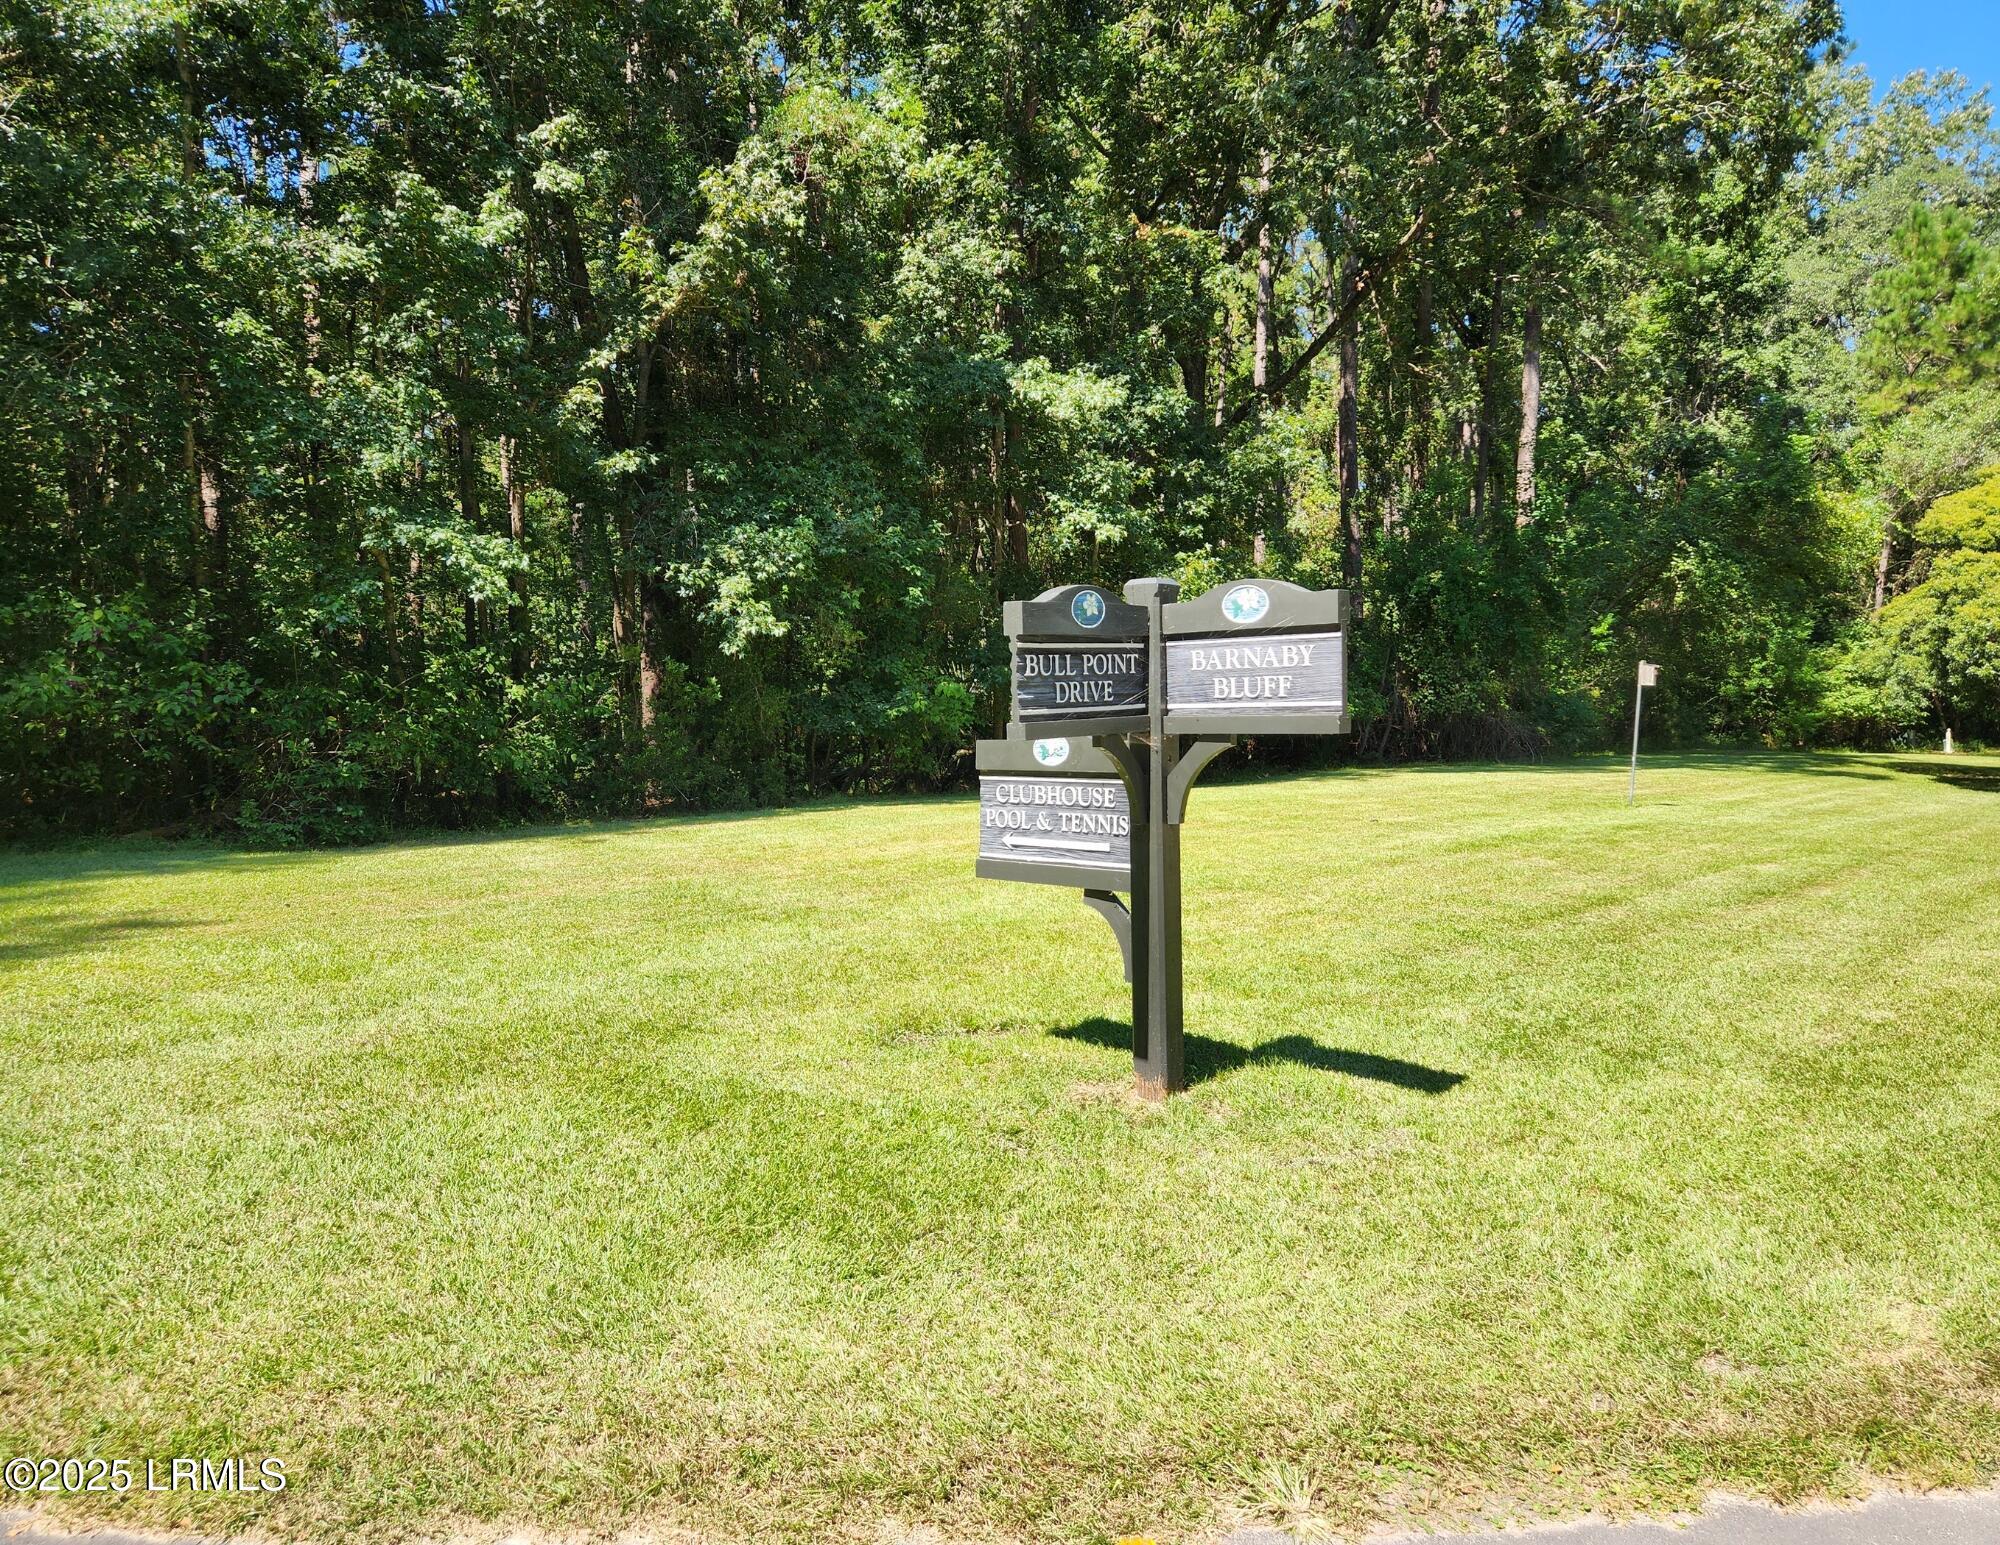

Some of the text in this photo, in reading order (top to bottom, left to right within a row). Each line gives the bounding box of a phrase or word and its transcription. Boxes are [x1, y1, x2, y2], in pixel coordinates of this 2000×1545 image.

[1024, 653, 1139, 677] BULL POINT
[1190, 644, 1315, 671] BARNABY
[1055, 681, 1114, 704] DRIVE
[1213, 675, 1292, 700] BLUFF
[995, 784, 1117, 809] CLUBHOUSE
[985, 808, 1130, 836] POOL & TENNIS
